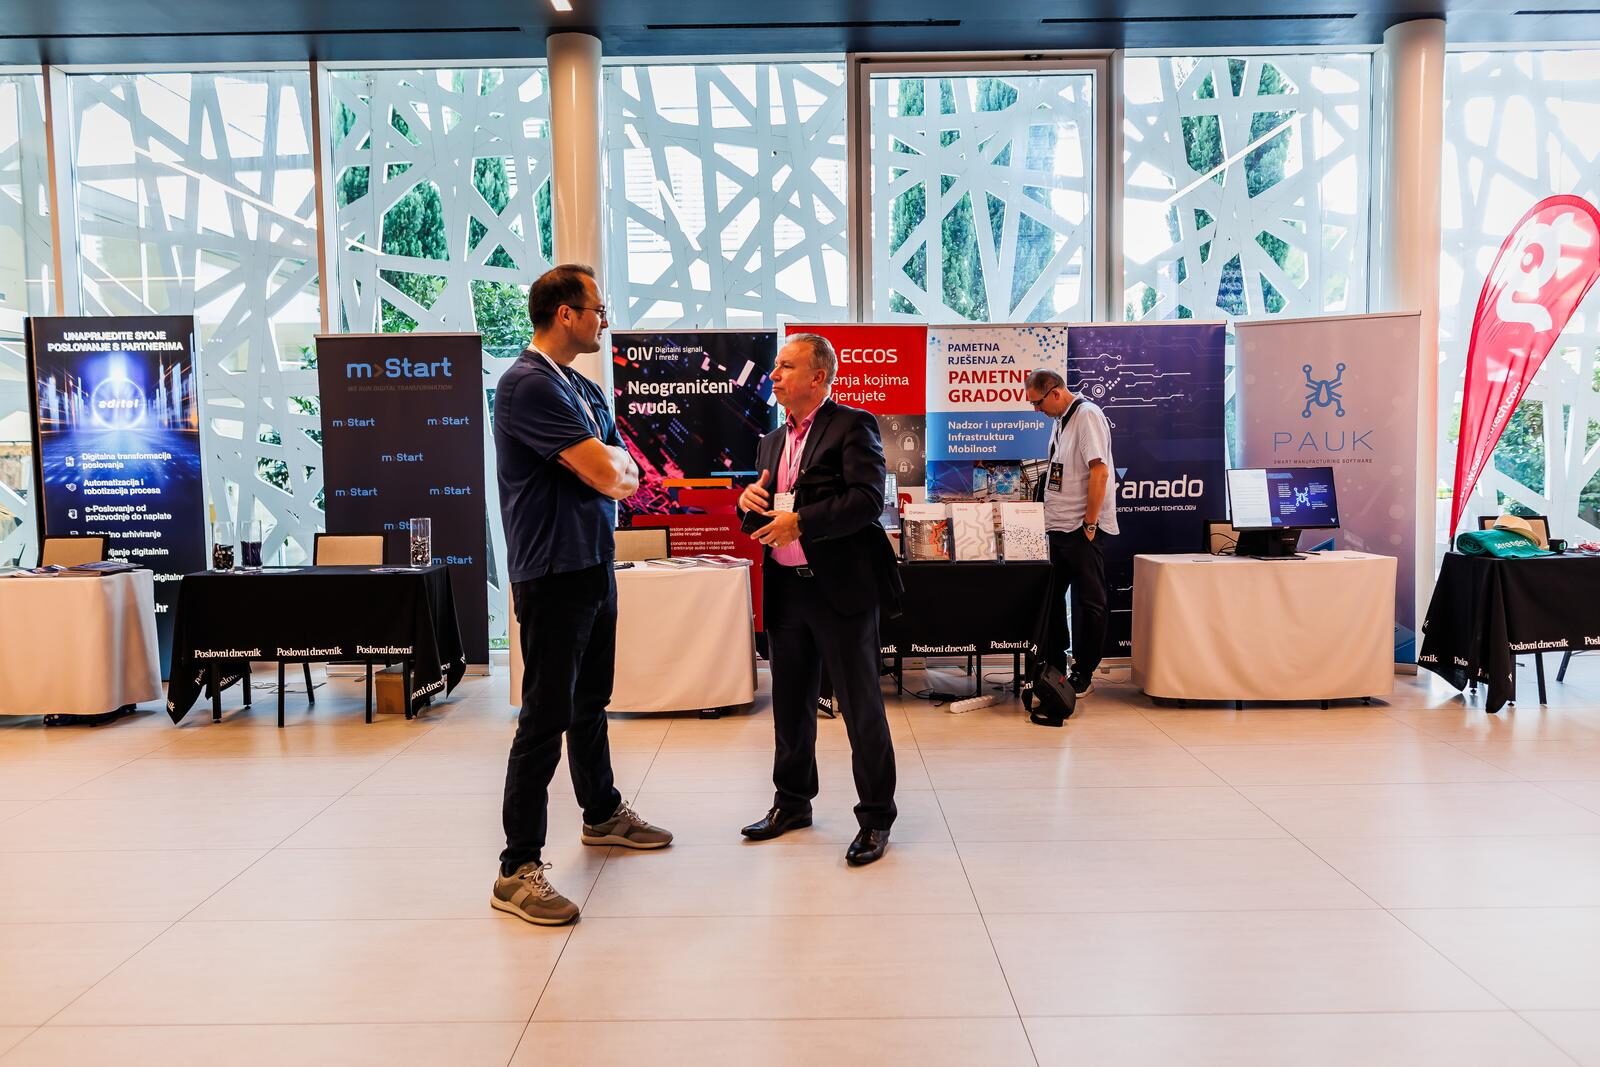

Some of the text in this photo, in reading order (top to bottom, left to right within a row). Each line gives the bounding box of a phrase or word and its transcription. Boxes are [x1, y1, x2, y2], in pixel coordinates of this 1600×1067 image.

[64, 331, 166, 341] UNAPRIJEDITE SVOJE
[48, 342, 184, 352] POSLOVANJE S PARTNERIMA
[948, 343, 1000, 352] PAMETNA
[626, 346, 703, 361] OIV Digitalni signali
[840, 348, 898, 364] ECCOS
[948, 354, 1016, 365] RJEŠENJA ZA
[864, 374, 910, 388] kojima
[628, 379, 733, 397] Neograničeni
[98, 398, 138, 409] editel
[628, 400, 681, 415] svuda.
[948, 420, 1045, 430] Nadzor i upravljanje
[948, 432, 1015, 441] Infrastruktura
[1273, 430, 1376, 452] PAUK
[948, 444, 997, 453] Mobilnost
[82, 452, 172, 462] Digitalna transformacija
[82, 462, 124, 470] poslovanja
[84, 479, 140, 488] Automatizacija
[84, 488, 161, 496] robotizacija procesa
[85, 504, 146, 514] e-Poslovanje od
[86, 514, 130, 522] proizvodnje
[144, 513, 172, 522] naplate
[122, 530, 162, 539] arhiviranje
[132, 548, 169, 557] digitalnim
[911, 644, 977, 652] Poslovni dnevnik
[990, 640, 1022, 649] Poslovni
[1538, 639, 1568, 648] dnevnik
[194, 648, 261, 658] Poslovni dnevnik
[276, 646, 343, 656] Poslovni dnevnik
[356, 645, 413, 654] Poslovni dnevni
